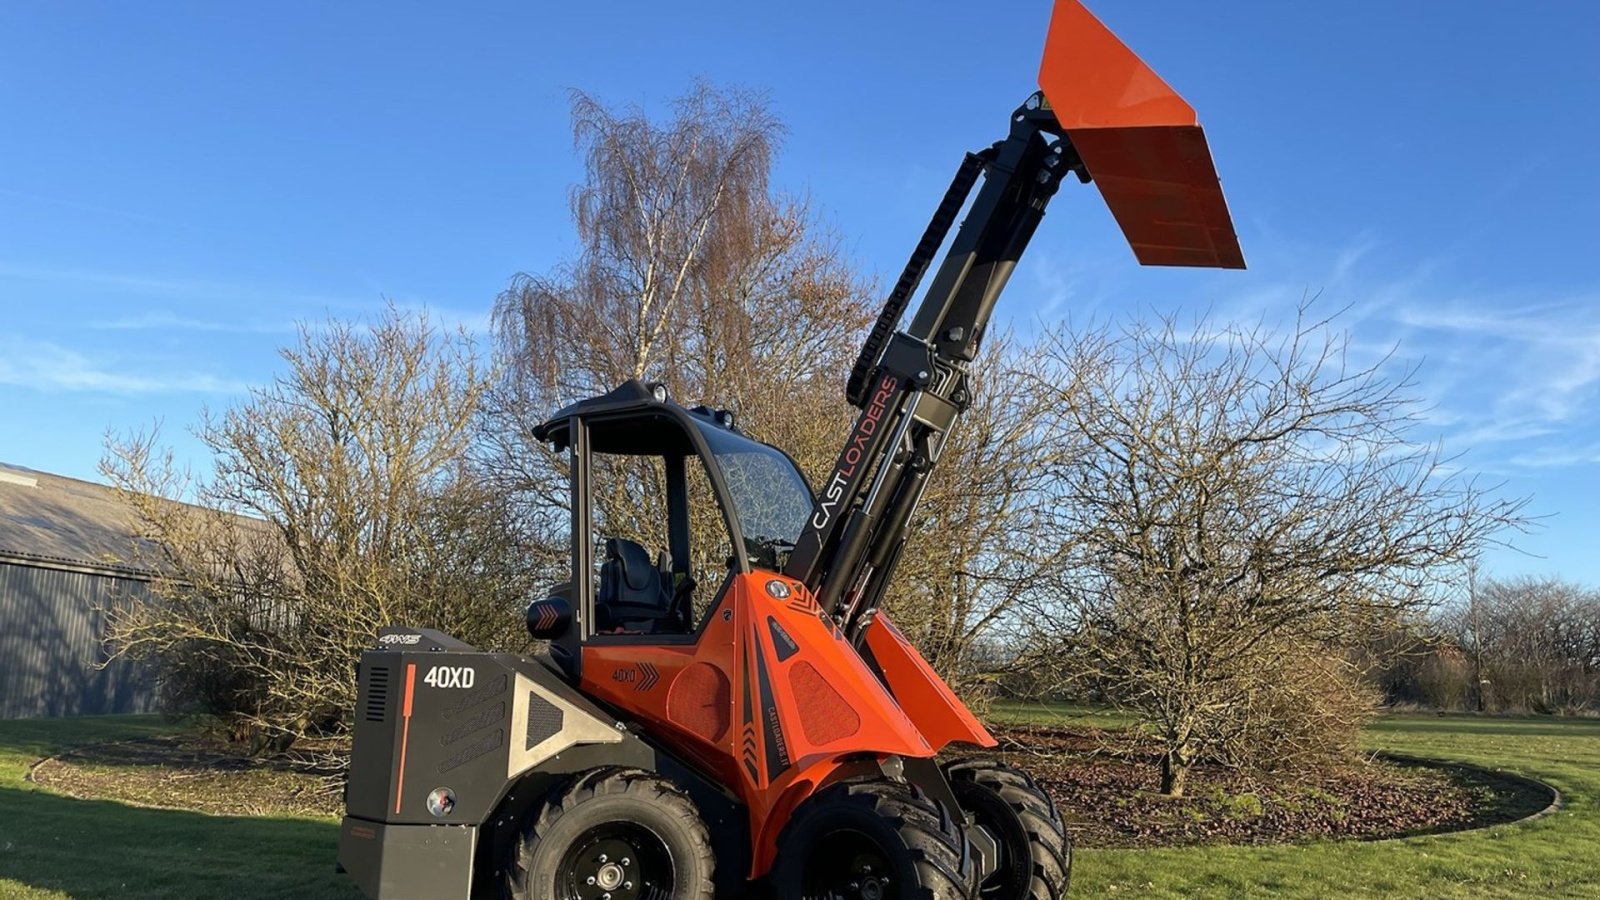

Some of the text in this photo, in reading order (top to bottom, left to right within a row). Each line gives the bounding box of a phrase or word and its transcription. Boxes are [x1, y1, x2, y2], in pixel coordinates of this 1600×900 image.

[813, 376, 898, 530] CASTLOADERS
[379, 634, 422, 645] 4WS
[423, 665, 475, 689] 40XD
